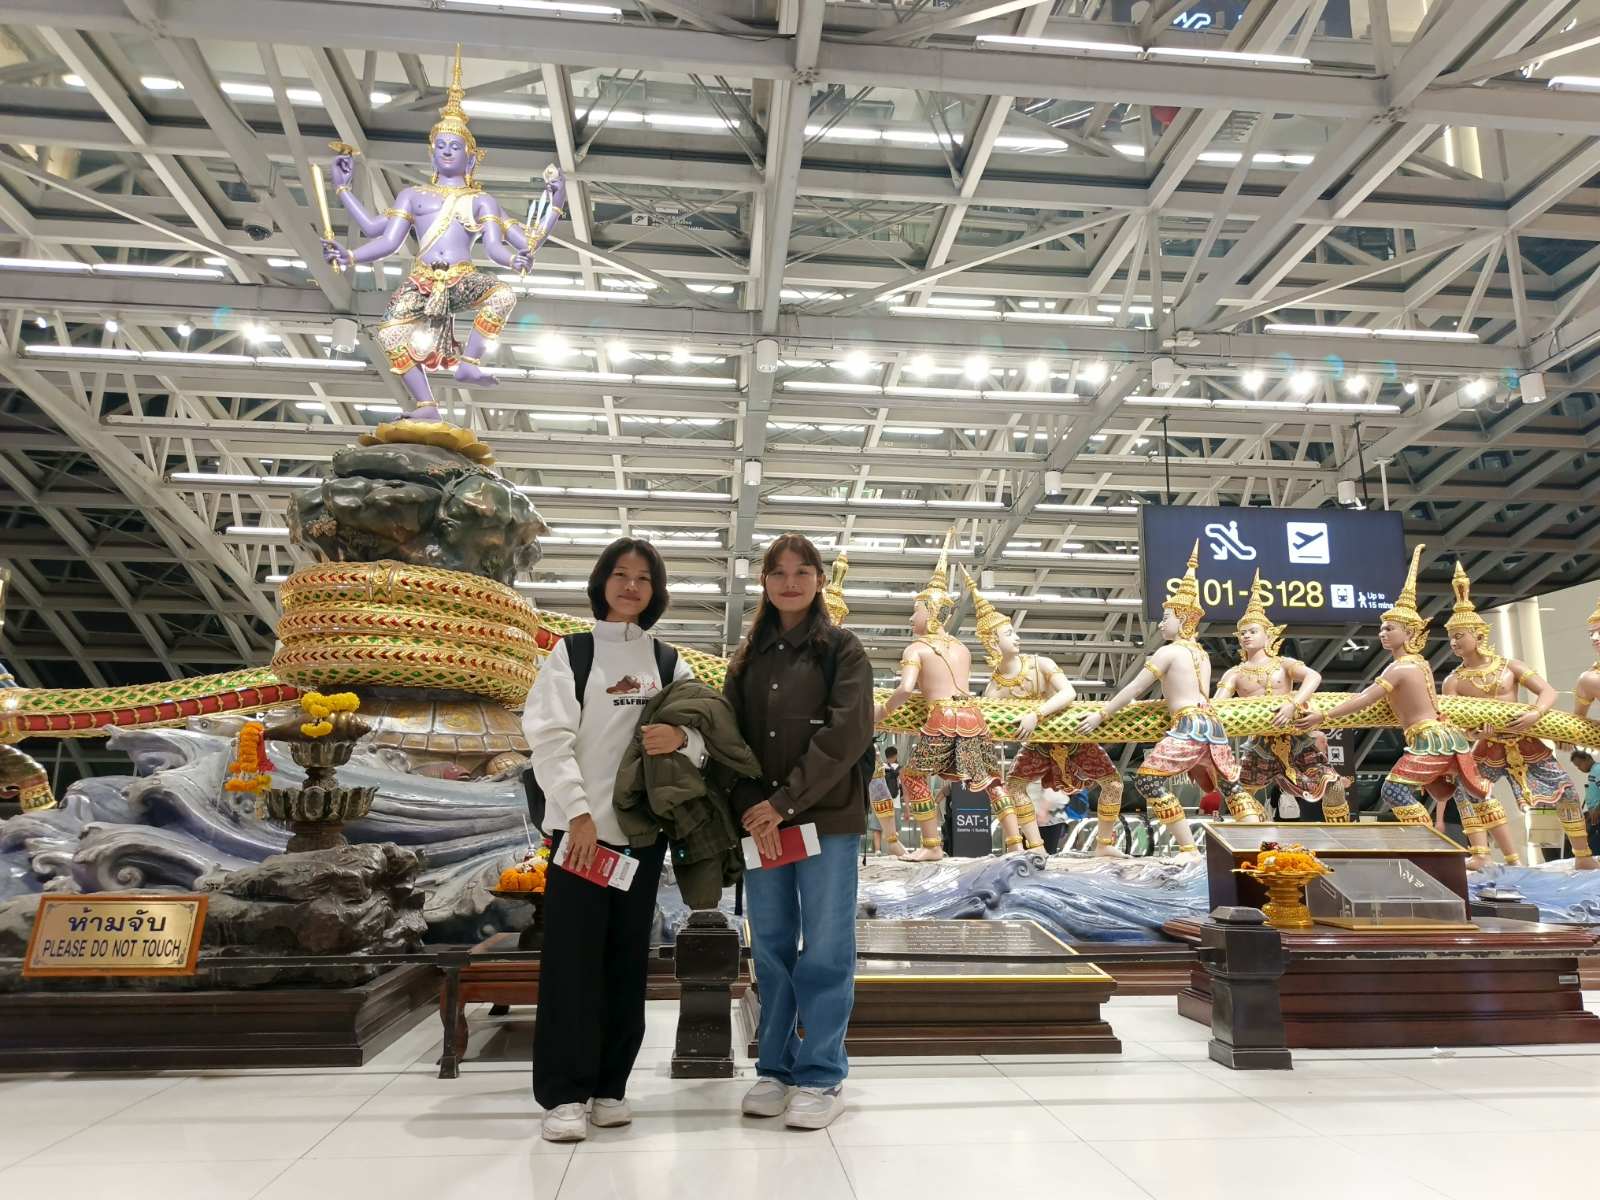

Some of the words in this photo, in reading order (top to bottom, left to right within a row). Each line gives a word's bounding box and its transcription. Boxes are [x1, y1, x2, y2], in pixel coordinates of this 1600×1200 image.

[1367, 592, 1377, 600] Up
[957, 815, 989, 826] SAT-1
[68, 907, 167, 932] ห้ามจับ
[43, 939, 87, 958] PLEASE
[90, 939, 109, 958] DO
[112, 939, 138, 958] NOT
[142, 938, 182, 958] TOUCH
